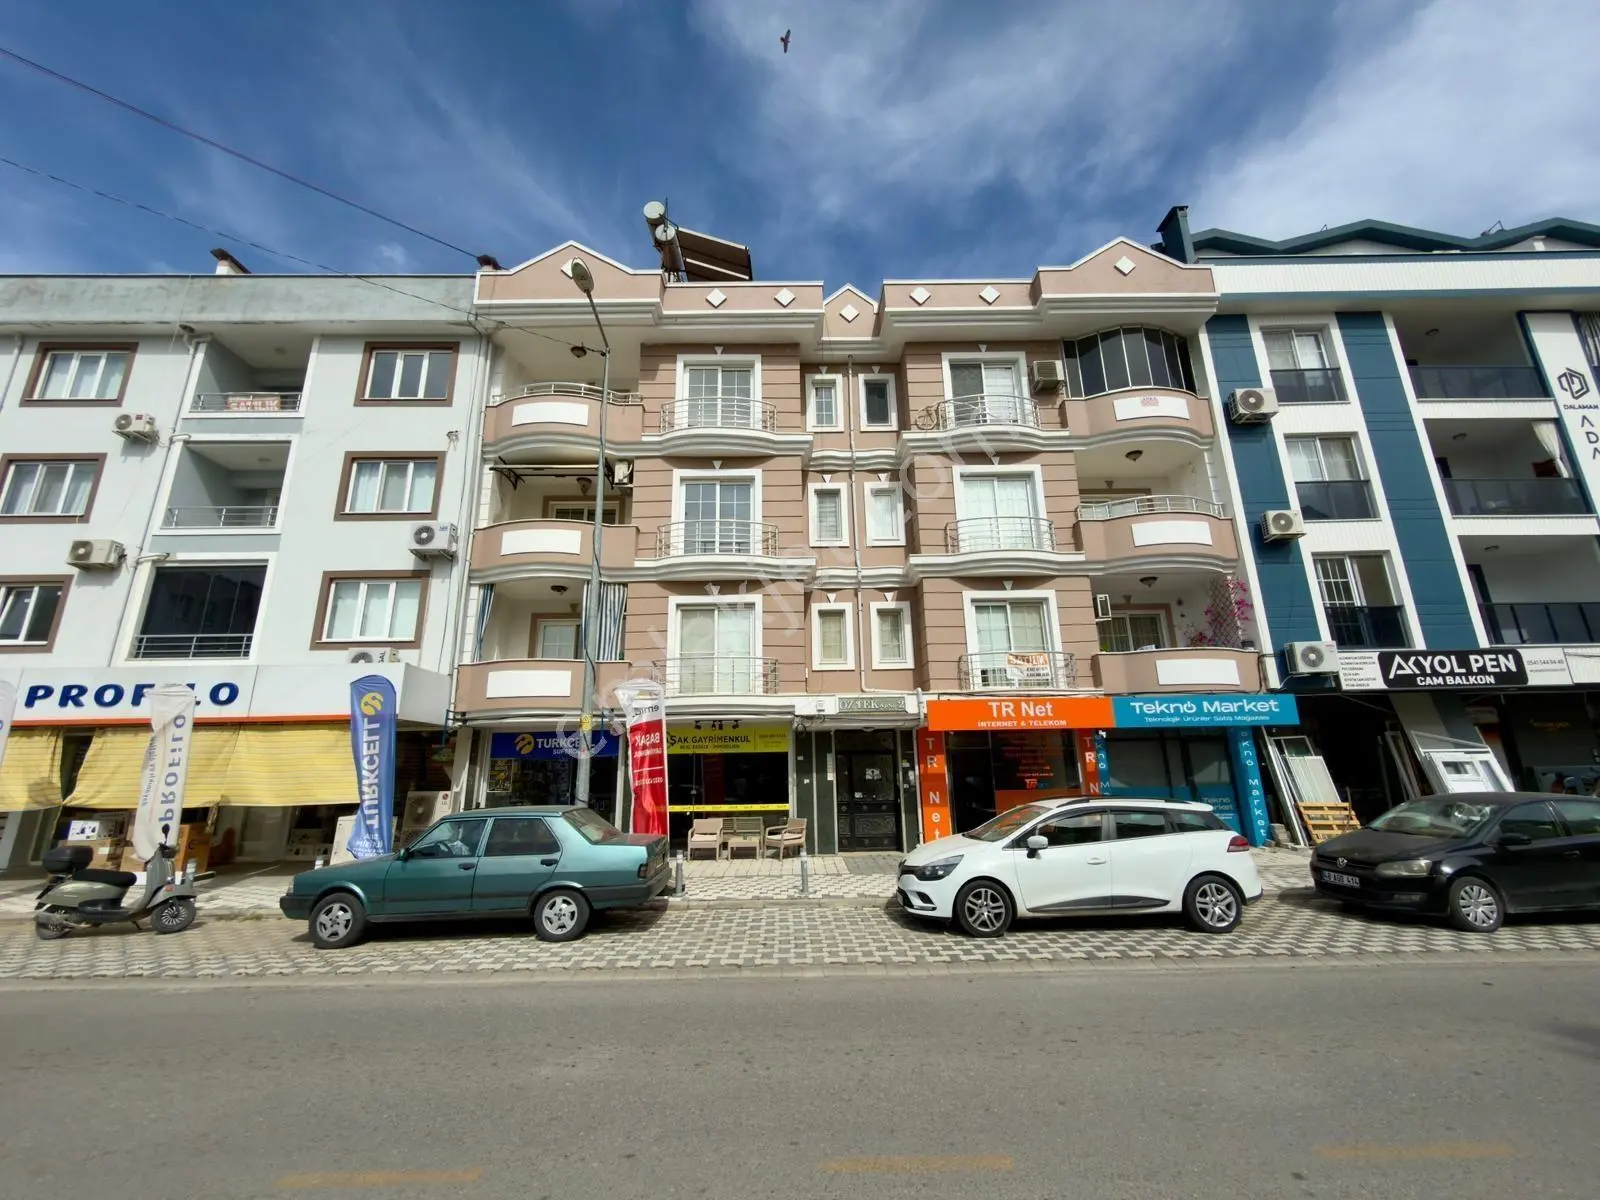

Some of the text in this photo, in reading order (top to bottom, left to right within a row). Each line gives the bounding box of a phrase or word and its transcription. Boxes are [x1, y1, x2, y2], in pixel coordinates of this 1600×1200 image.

[1010, 654, 1047, 666] SATILIK
[1389, 654, 1517, 679] AKYOL PEN
[1416, 675, 1496, 686] CAM BALKON
[24, 682, 240, 709] PROFO
[988, 701, 1054, 718] TR Net
[1203, 699, 1280, 713] Market
[1030, 719, 1067, 727] TELEKOM
[536, 738, 595, 749] TURKCE
[692, 733, 751, 744] GAYRİMENKUL
[925, 738, 942, 840] TR Net
[1249, 778, 1267, 836] Market
